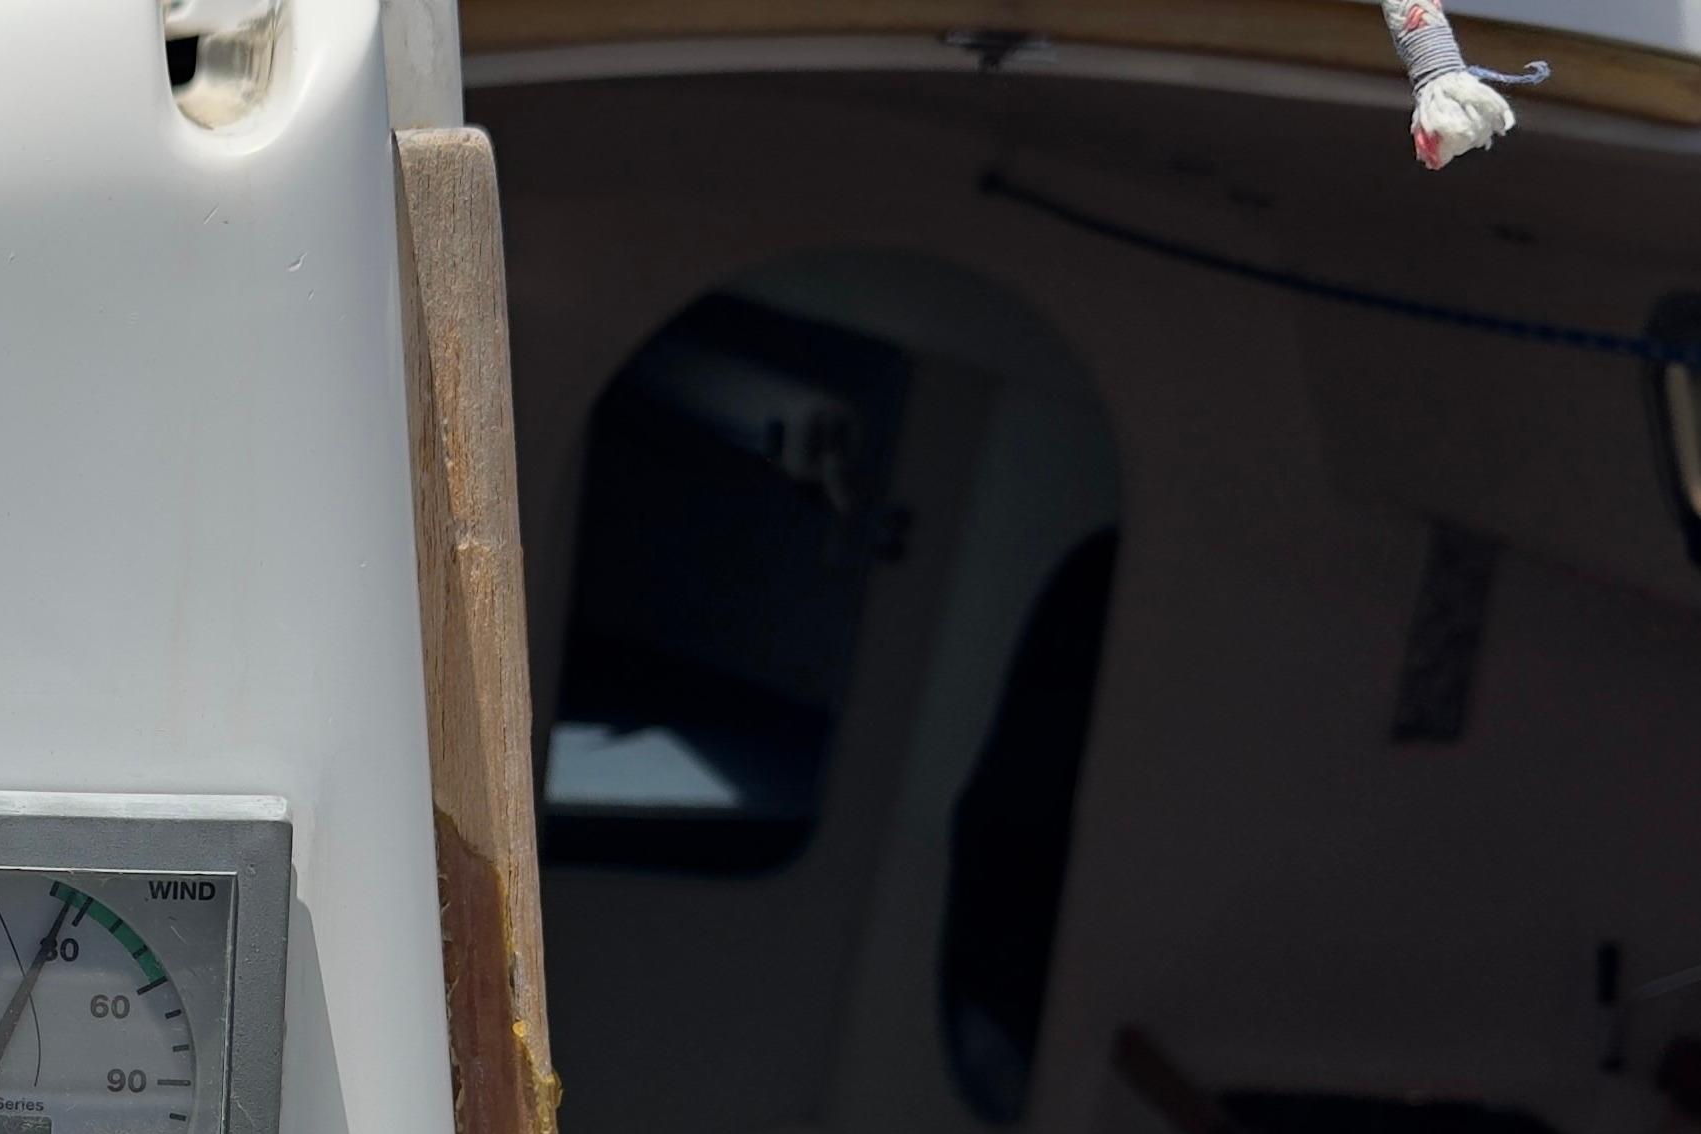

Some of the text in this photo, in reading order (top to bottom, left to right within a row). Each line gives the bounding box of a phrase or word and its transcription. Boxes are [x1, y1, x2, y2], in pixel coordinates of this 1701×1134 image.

[148, 880, 217, 901] WIND
[90, 994, 131, 1019] 60
[107, 1069, 148, 1093] 90
